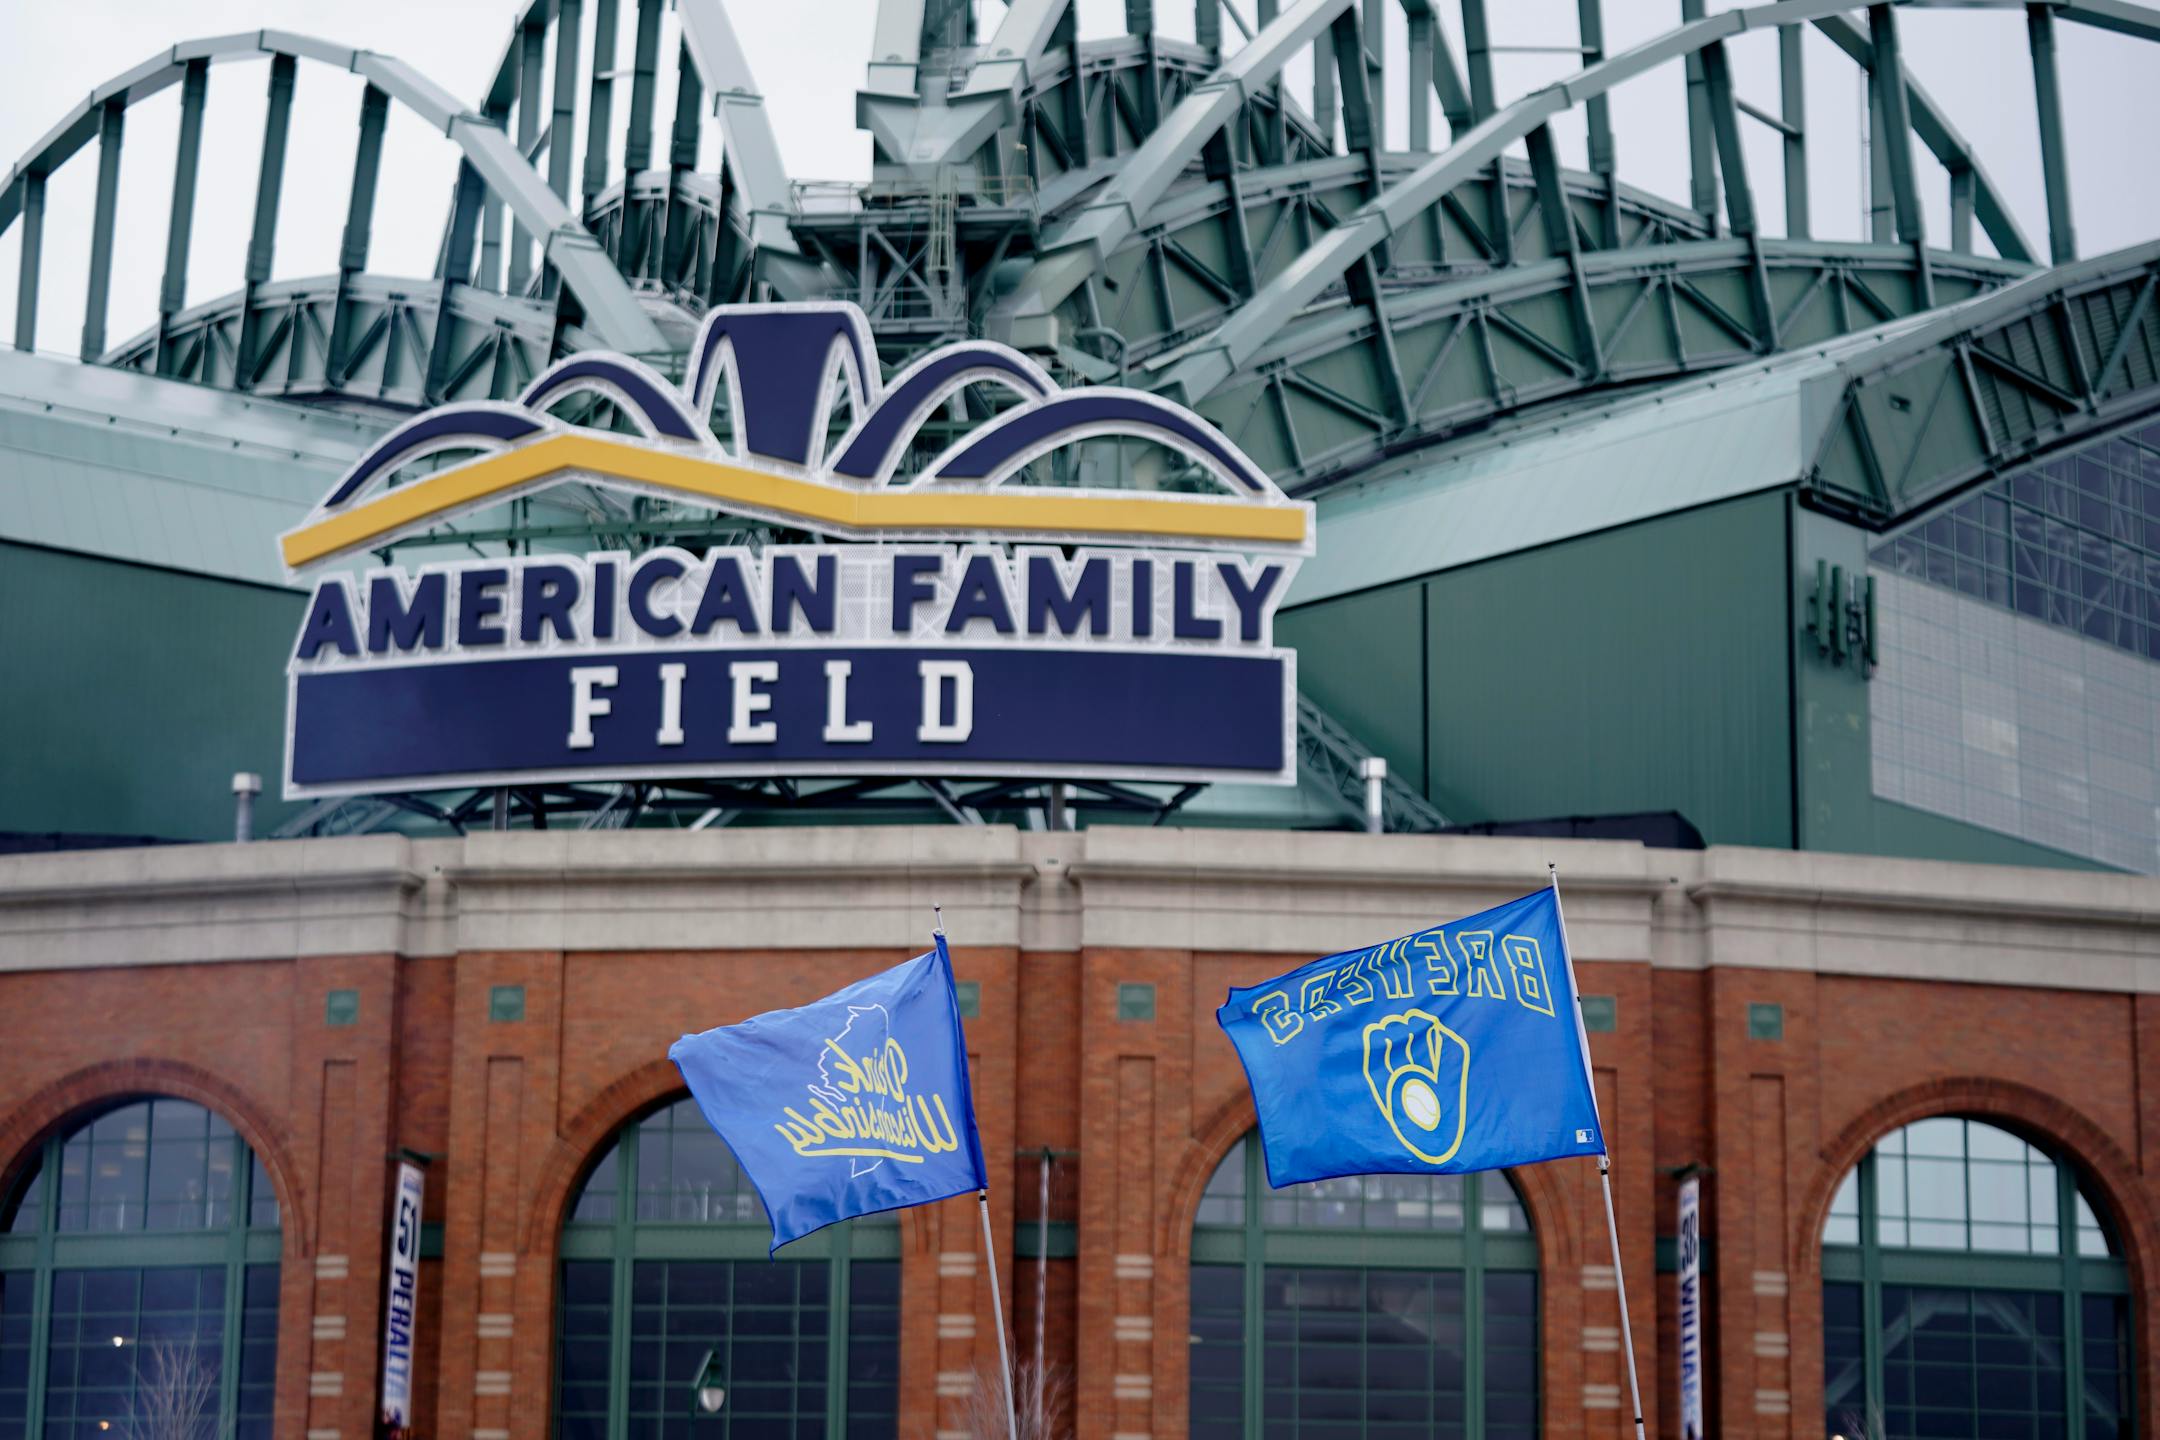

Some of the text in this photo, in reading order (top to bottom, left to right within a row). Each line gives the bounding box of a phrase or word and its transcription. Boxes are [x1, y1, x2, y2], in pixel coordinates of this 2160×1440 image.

[297, 554, 1285, 660] AMERICAN FAMILY
[568, 660, 975, 750] FIELD
[398, 1197, 417, 1264] 51
[387, 1268, 414, 1400] PERALTA
